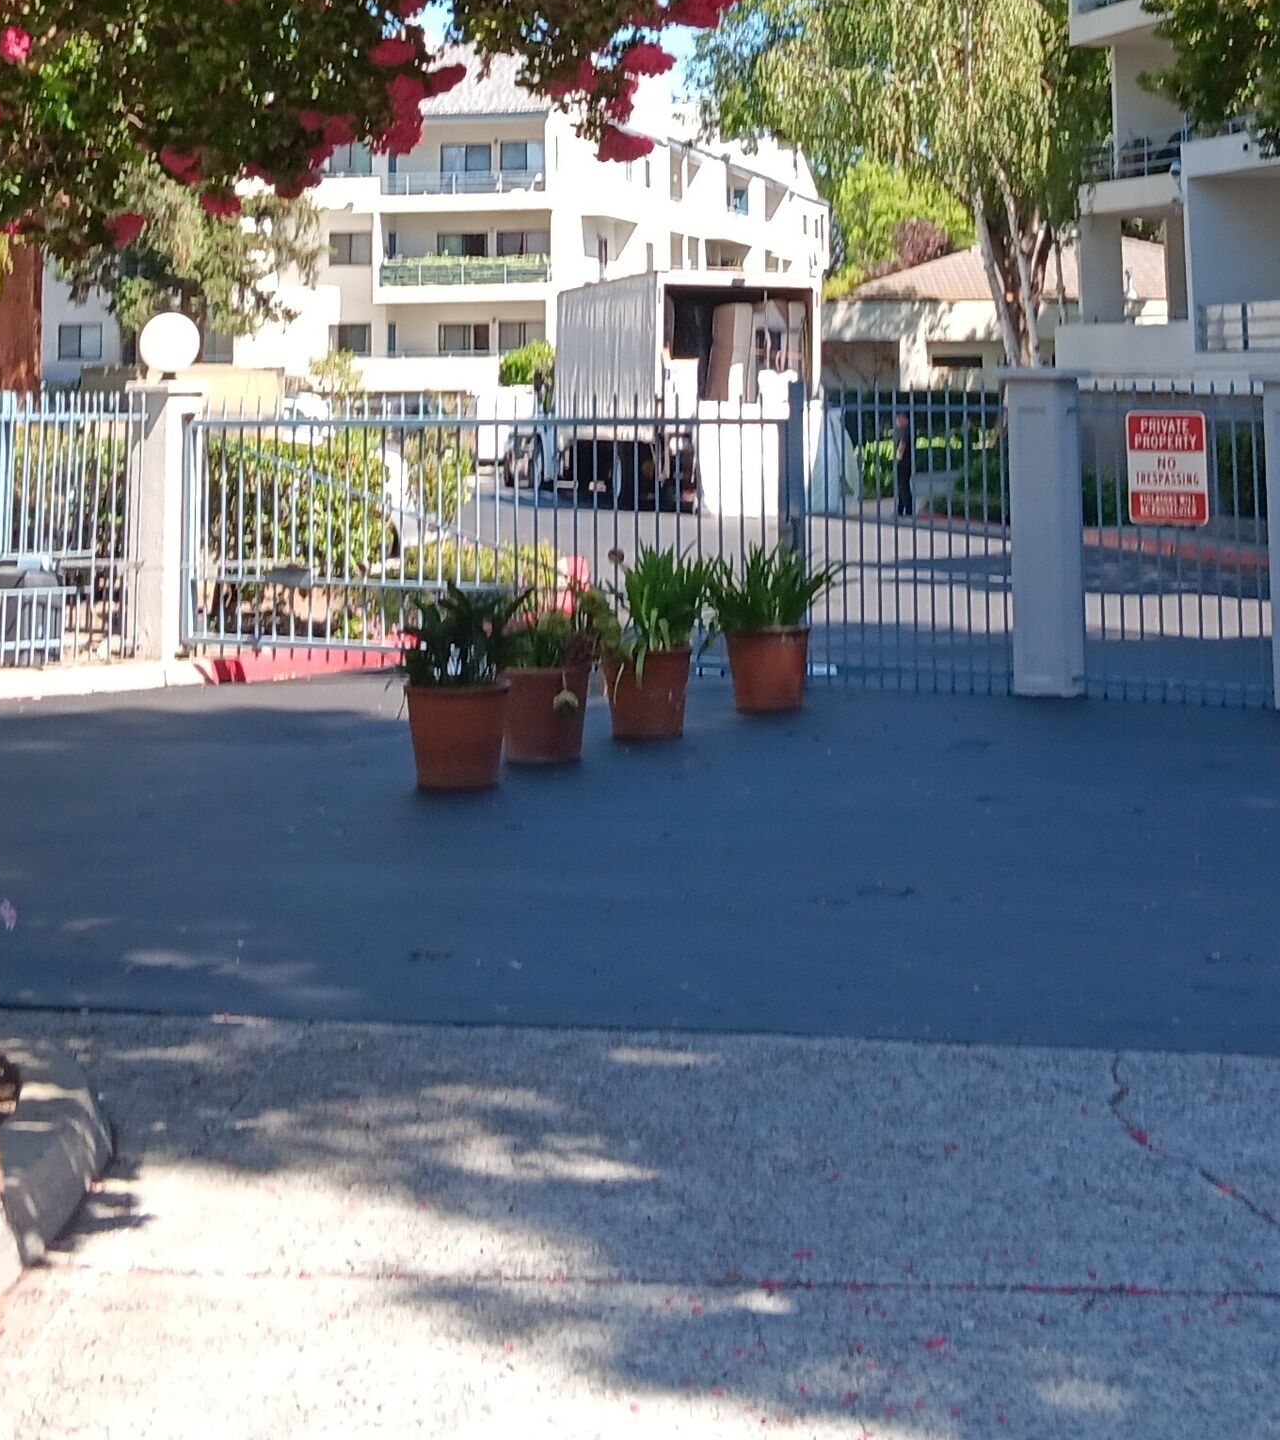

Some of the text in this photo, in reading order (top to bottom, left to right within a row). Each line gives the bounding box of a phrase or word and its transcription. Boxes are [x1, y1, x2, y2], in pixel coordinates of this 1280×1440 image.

[1140, 418, 1190, 434] PRIVATE
[1134, 433, 1197, 450] PROPERTY
[1157, 456, 1176, 470] NO
[1136, 471, 1200, 486] TRESPASSING
